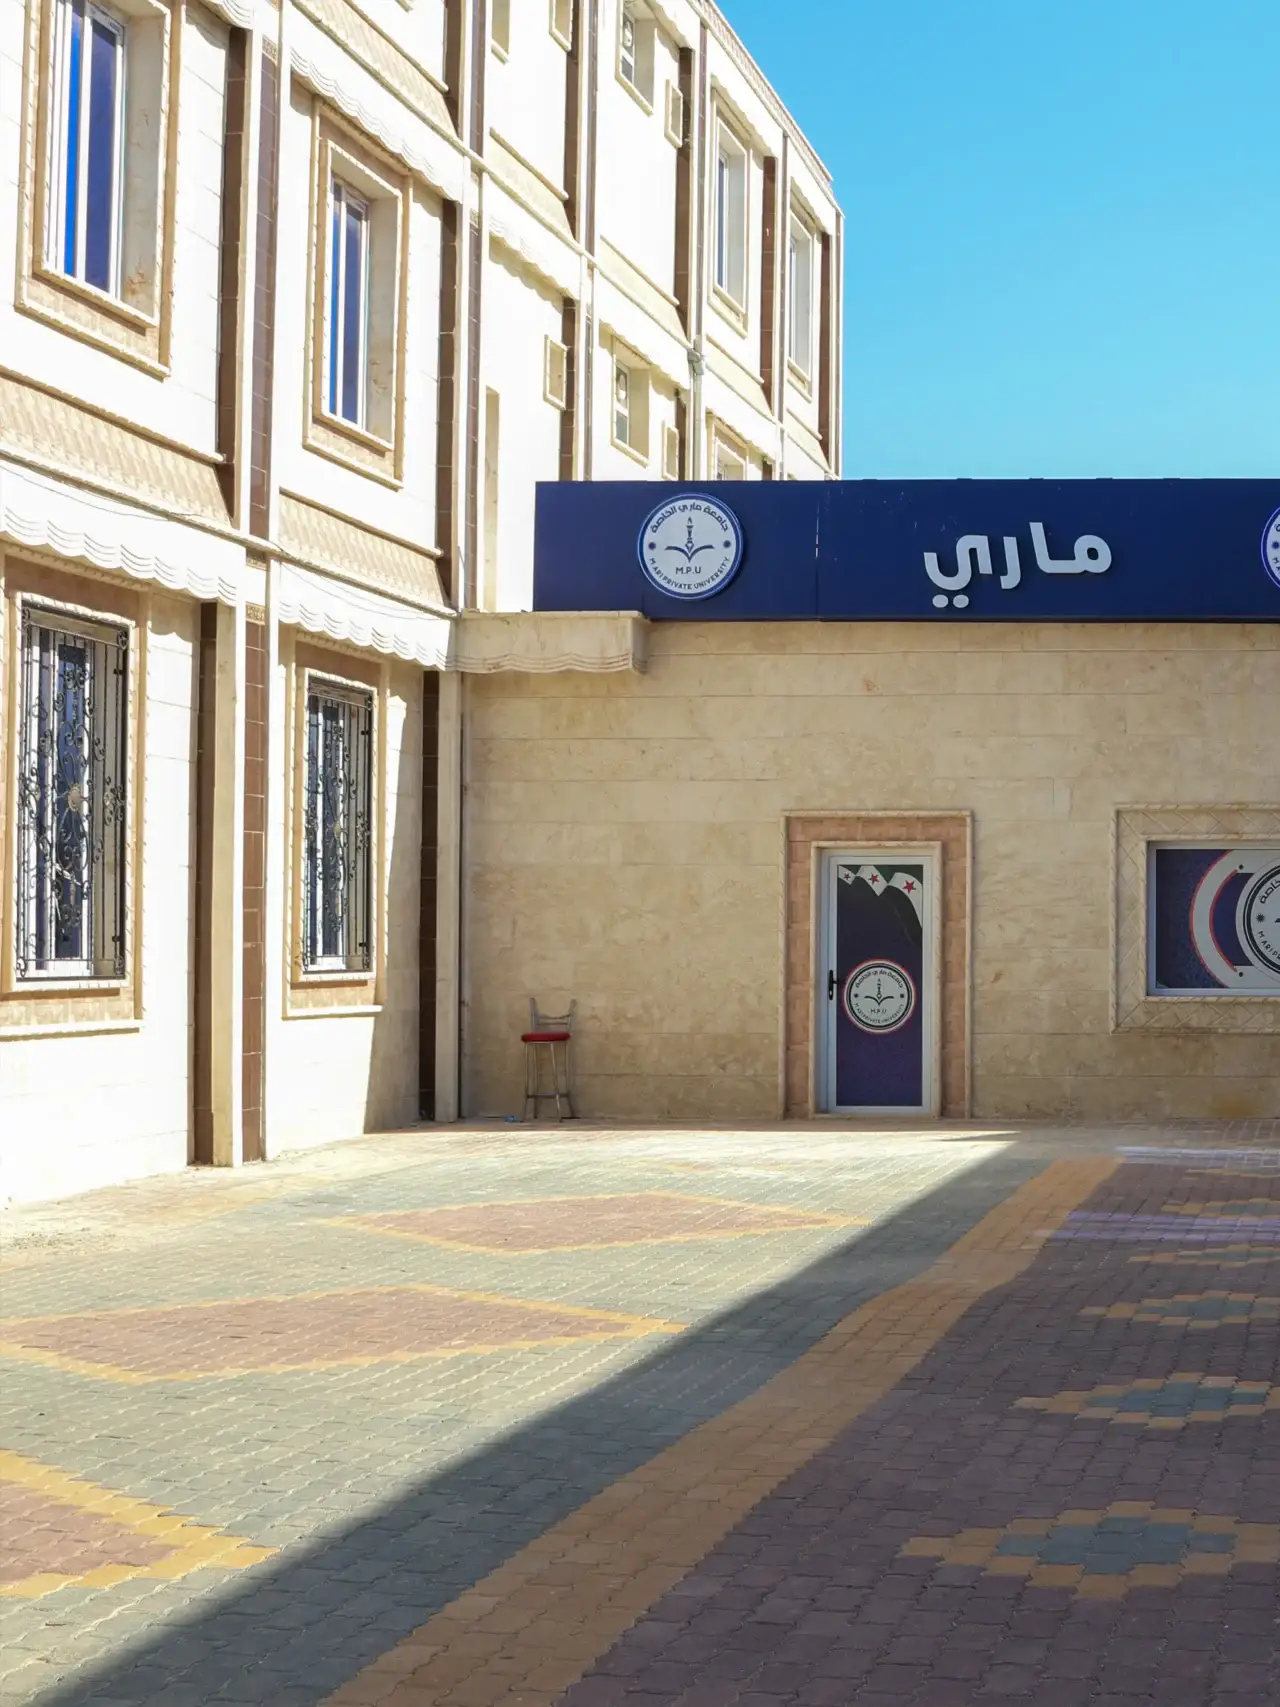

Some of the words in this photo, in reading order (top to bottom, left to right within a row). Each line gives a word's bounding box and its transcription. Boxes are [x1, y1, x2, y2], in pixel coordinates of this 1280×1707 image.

[650, 505, 677, 533] الخاصة
[678, 502, 702, 512] ماري
[703, 505, 729, 532] جامعة
[662, 575, 692, 590] PRIVATE
[694, 556, 730, 590] UNIVERSITY
[675, 566, 702, 574] M.P.U
[923, 521, 1112, 609] ماري
